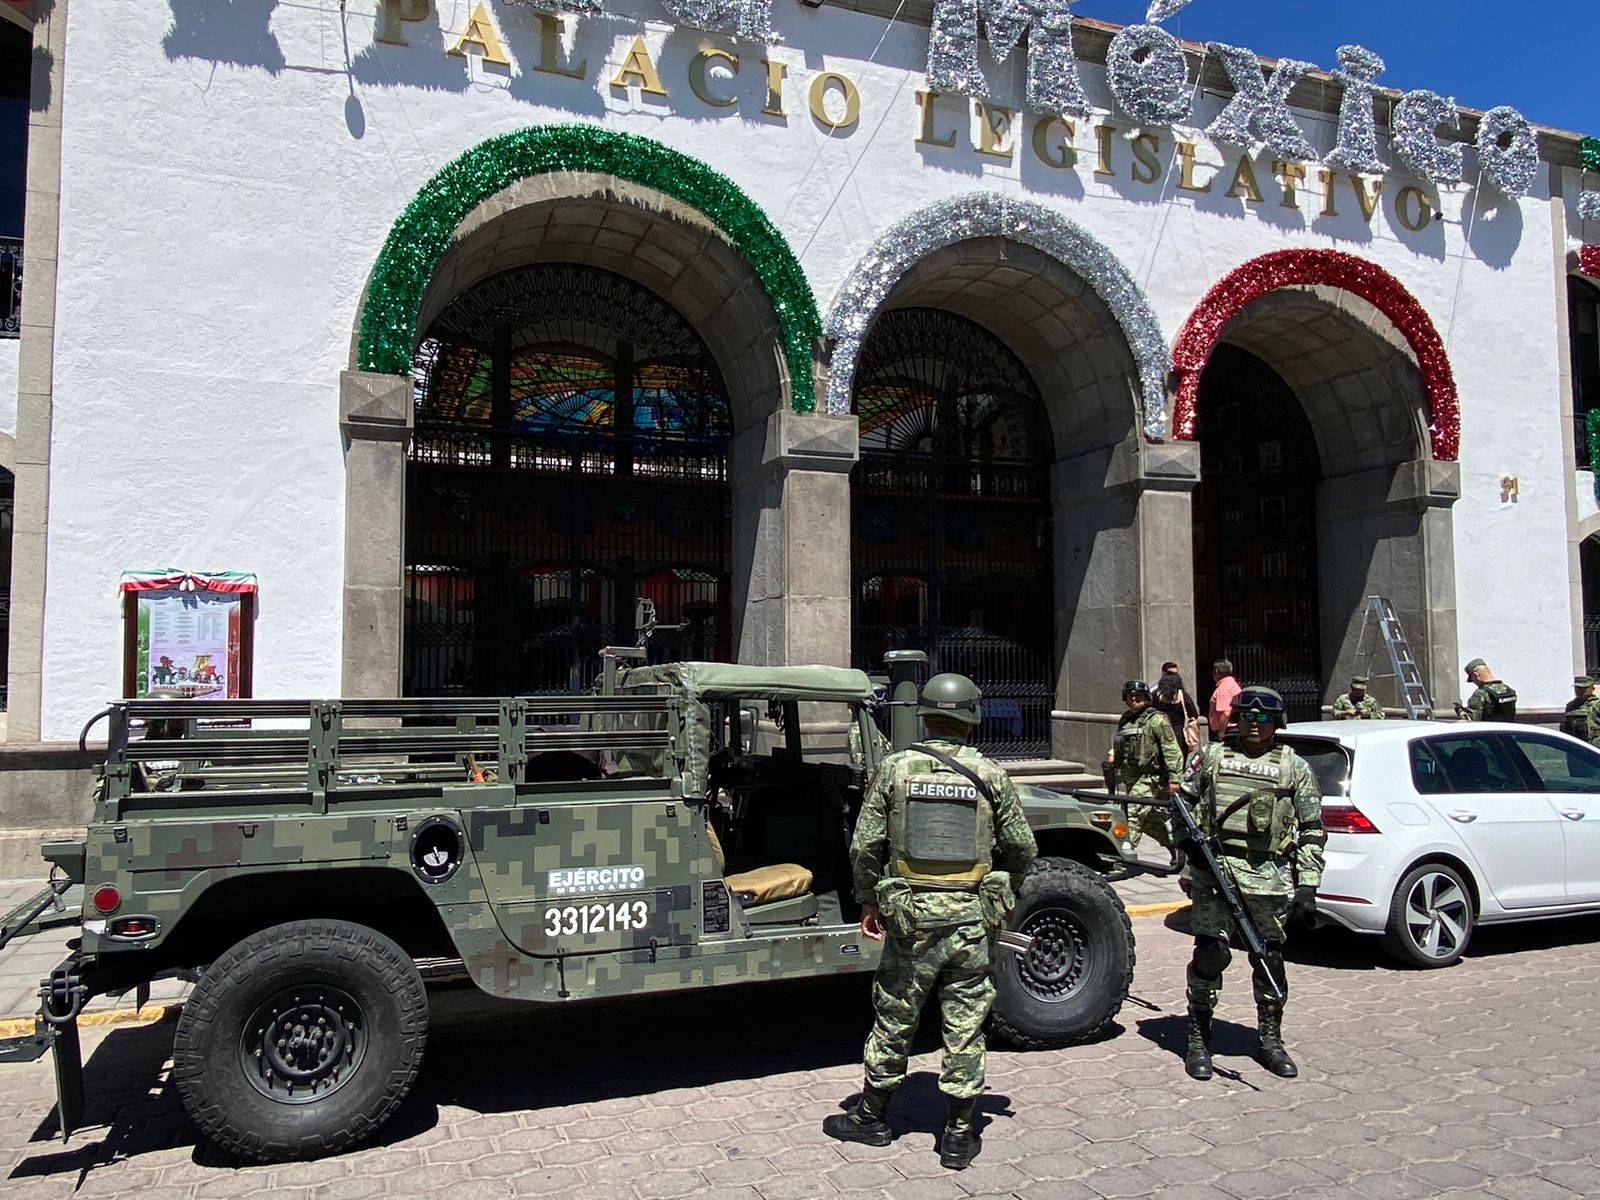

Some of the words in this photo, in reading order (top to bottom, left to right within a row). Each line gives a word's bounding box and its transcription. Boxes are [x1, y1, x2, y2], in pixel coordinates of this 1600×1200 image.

[375, 0, 862, 128] PALACIO
[914, 90, 1433, 232] LEGISLATIVO
[910, 782, 977, 799] EJÉRCITO
[549, 866, 645, 888] EJÉRCITO
[556, 882, 638, 894] MEXICANO
[544, 900, 649, 937] 3312143
